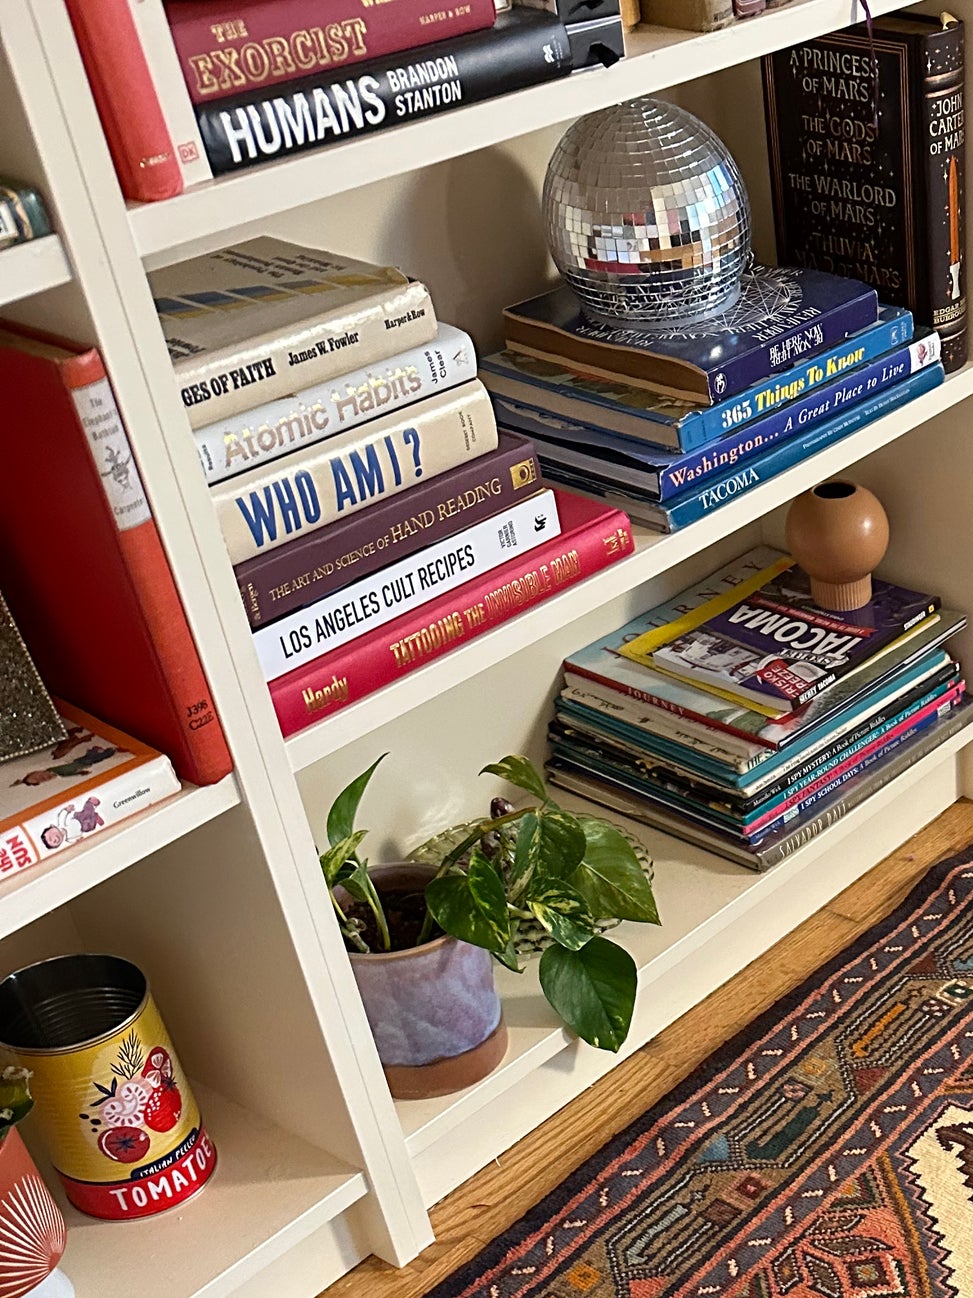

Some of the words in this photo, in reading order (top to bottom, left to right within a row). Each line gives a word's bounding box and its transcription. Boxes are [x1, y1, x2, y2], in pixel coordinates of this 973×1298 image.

[210, 19, 248, 43] THE
[419, 12, 446, 25] HARPER
[188, 17, 368, 95] EXORCIST
[387, 55, 459, 92] BRANDON
[790, 50, 799, 66] A
[803, 48, 879, 78] PRINCESS
[395, 80, 462, 116] STANTON
[802, 76, 819, 93] OF
[823, 76, 869, 102] MARS
[936, 92, 963, 117] JOHN
[219, 75, 387, 163] HUMANS
[802, 115, 825, 134] THE
[830, 117, 875, 143] GODS
[929, 112, 965, 137] CARTE
[807, 139, 823, 154] OF
[826, 139, 872, 165] MARS
[930, 143, 942, 155] OF
[788, 173, 812, 191] THE
[814, 174, 897, 208] WARLORD
[811, 201, 827, 215] OF
[830, 200, 875, 226] MARS
[288, 346, 318, 367] James
[328, 332, 360, 352] Fowler
[424, 350, 438, 384] James
[435, 350, 447, 379] Clear
[180, 379, 211, 408] GES
[211, 370, 230, 397] OF
[231, 358, 277, 391] FAITH
[721, 400, 751, 429] 365
[755, 378, 805, 413] Things
[807, 364, 824, 386] To
[826, 347, 866, 378] Know
[223, 400, 330, 468] Atomic
[331, 364, 423, 422] Habits
[669, 431, 780, 489] Washington...
[784, 416, 794, 432] A
[799, 400, 830, 426] Great
[834, 384, 863, 408] Place
[866, 375, 878, 391] to
[881, 361, 905, 382] Live
[235, 469, 321, 548] WHO
[329, 444, 385, 512] AM
[698, 467, 760, 510] TACOMA
[268, 583, 292, 601] THE
[290, 573, 310, 592] ART
[311, 562, 335, 582] AND
[335, 542, 375, 570] SCIENCE
[376, 535, 390, 551] OF
[390, 510, 435, 544] HAND
[436, 478, 502, 522] READING
[280, 625, 312, 659] LOS
[315, 591, 381, 642] ANGELES
[381, 572, 415, 608] CULT
[418, 544, 475, 590] RECIPES
[389, 612, 465, 667] TATTOOING
[463, 603, 486, 629] THE
[485, 566, 551, 623] INVISIBLE
[550, 549, 581, 586] MAN
[728, 604, 865, 660] TACOMA
[301, 674, 349, 713] Hardy
[628, 687, 686, 716] JOURNEY
[869, 716, 886, 730] Riddles
[787, 784, 799, 797] SPY
[799, 758, 839, 790] YEAR-ROUND
[885, 720, 898, 731] Book
[920, 693, 937, 707] Riddles
[804, 796, 817, 808] SPY
[817, 780, 842, 799] SCHOOL
[865, 755, 877, 767] Book
[900, 728, 918, 742] Riddles
[113, 786, 151, 809] Greenwillow
[6, 835, 32, 868] SUN
[780, 817, 823, 858] SALVADOR
[109, 1136, 212, 1211] TOMATOE
[140, 1156, 173, 1178] ITALIAN
